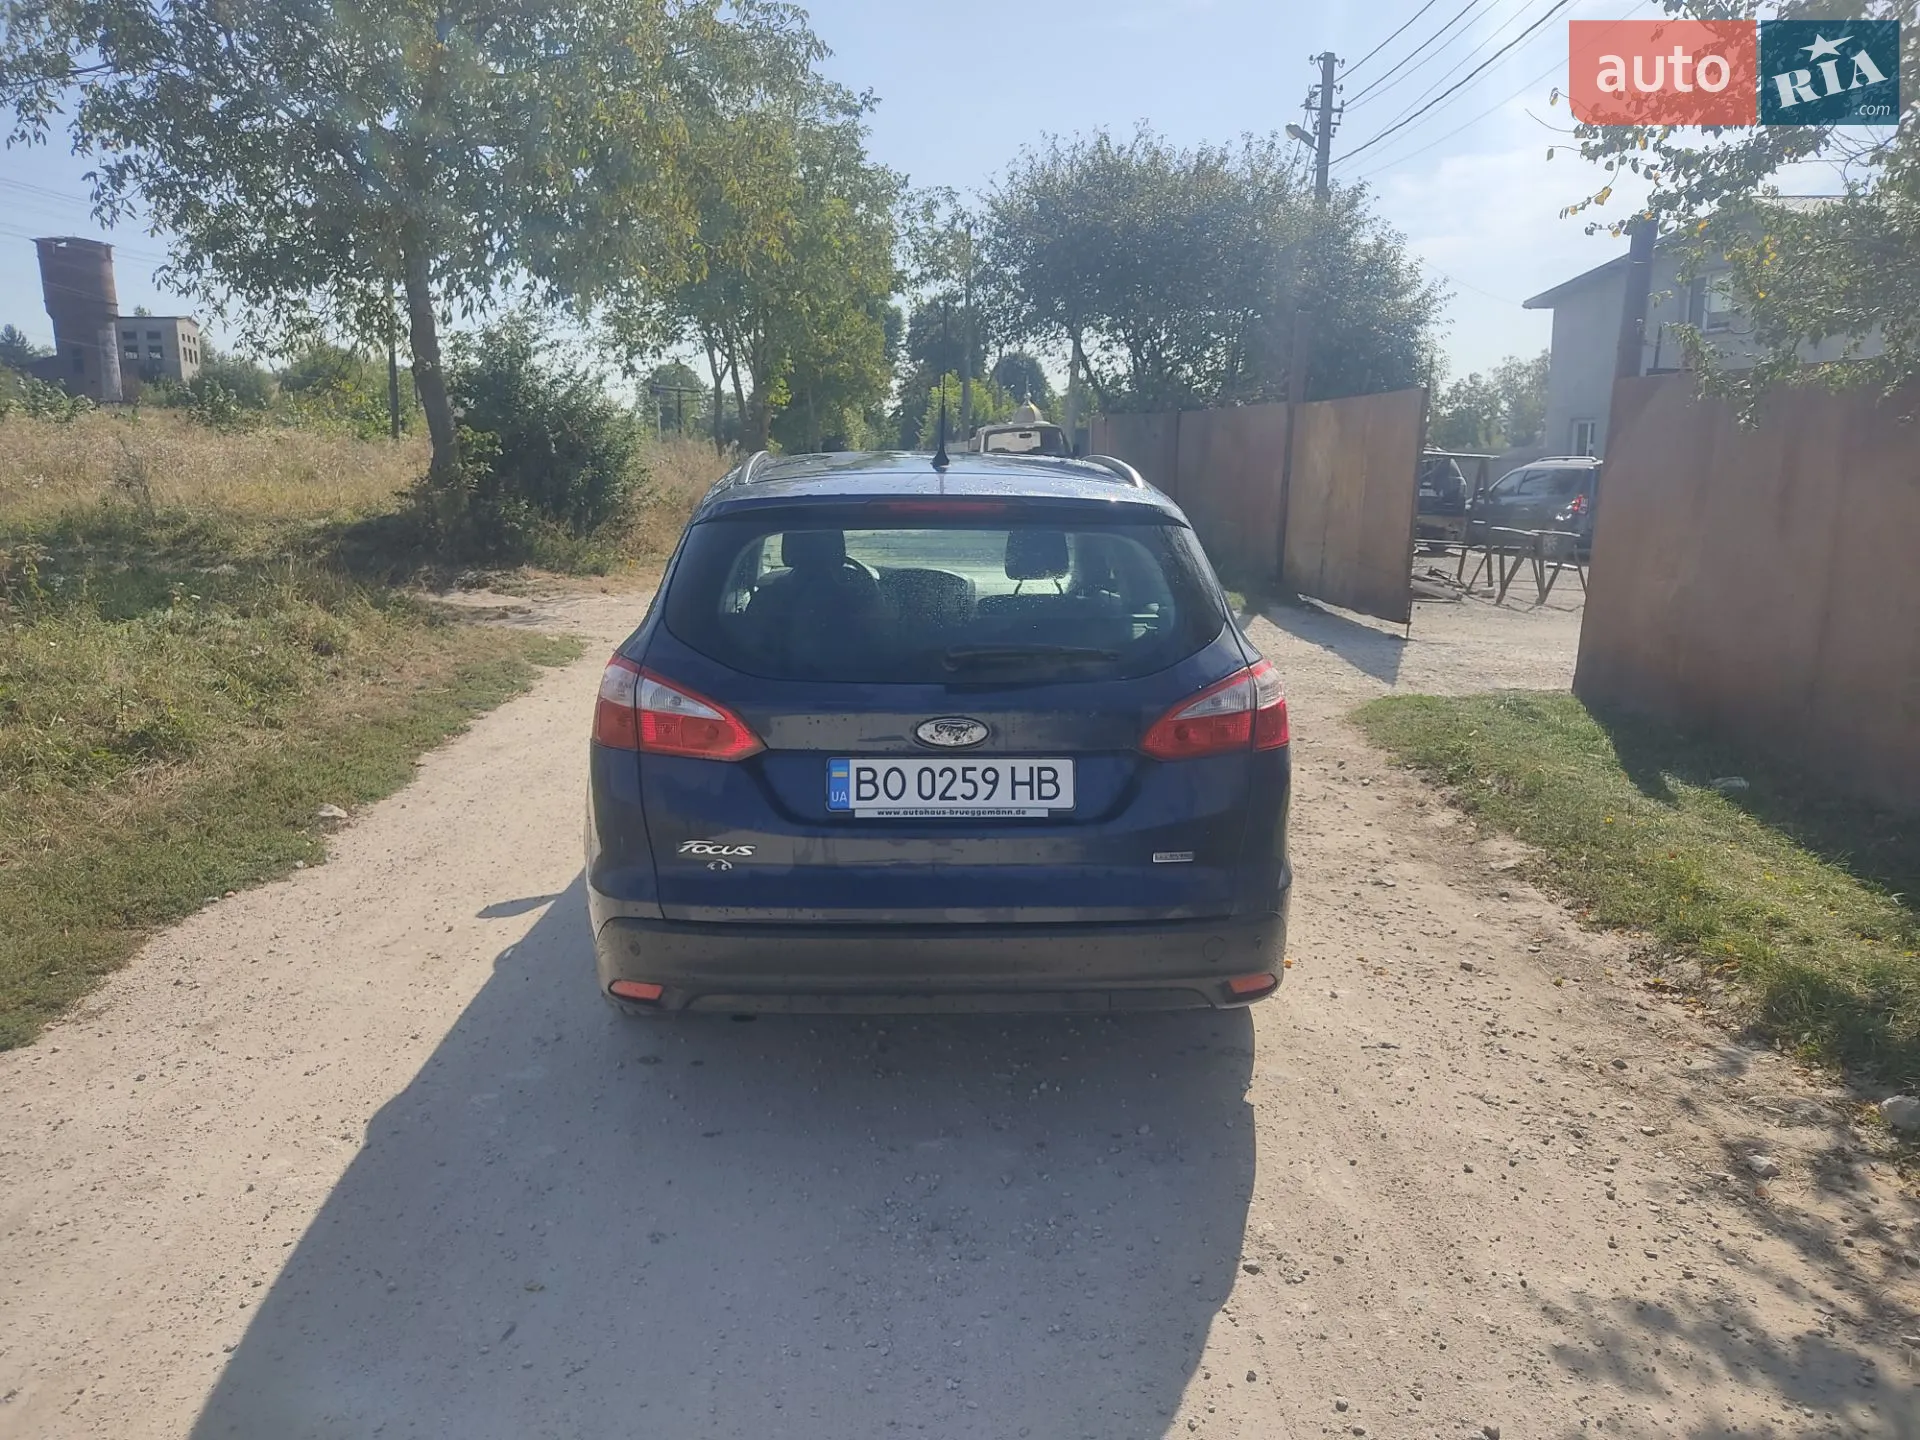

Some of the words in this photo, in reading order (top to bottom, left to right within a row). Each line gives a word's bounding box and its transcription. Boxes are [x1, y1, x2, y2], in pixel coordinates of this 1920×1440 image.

[855, 766, 906, 801] BO
[917, 766, 1000, 801] 0259
[1010, 766, 1061, 801] HB
[831, 791, 848, 802] UA
